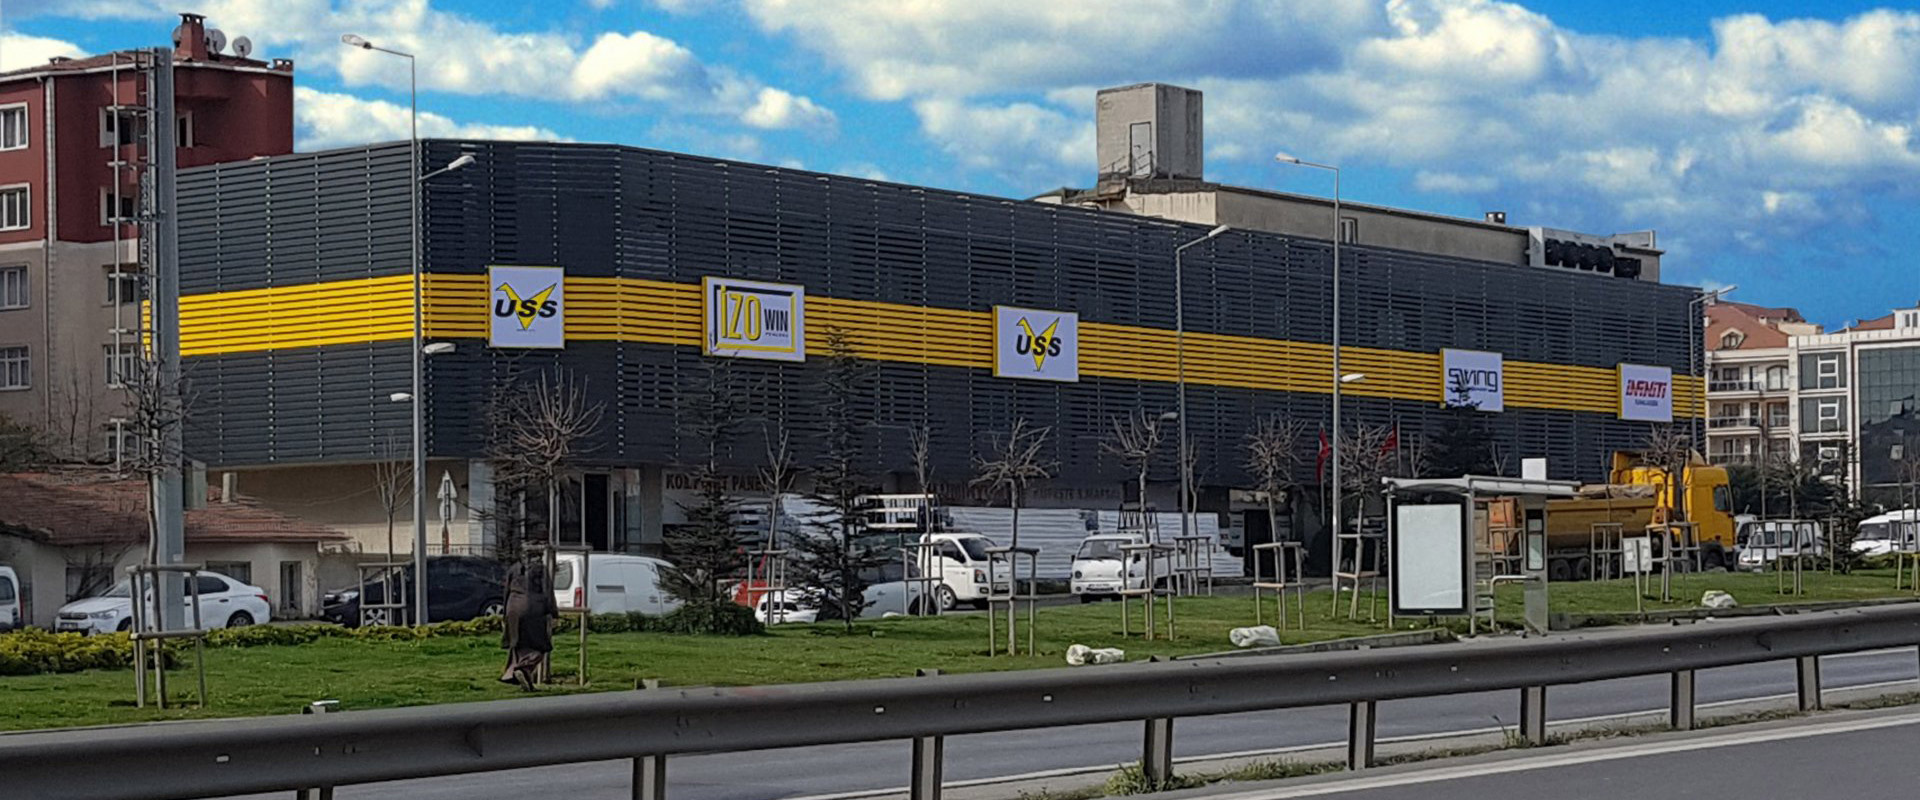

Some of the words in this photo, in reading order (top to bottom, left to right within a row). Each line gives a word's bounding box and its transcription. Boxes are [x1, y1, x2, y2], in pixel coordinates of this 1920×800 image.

[495, 299, 558, 318] USS
[764, 309, 788, 332] WIN
[1016, 334, 1061, 357] USS
